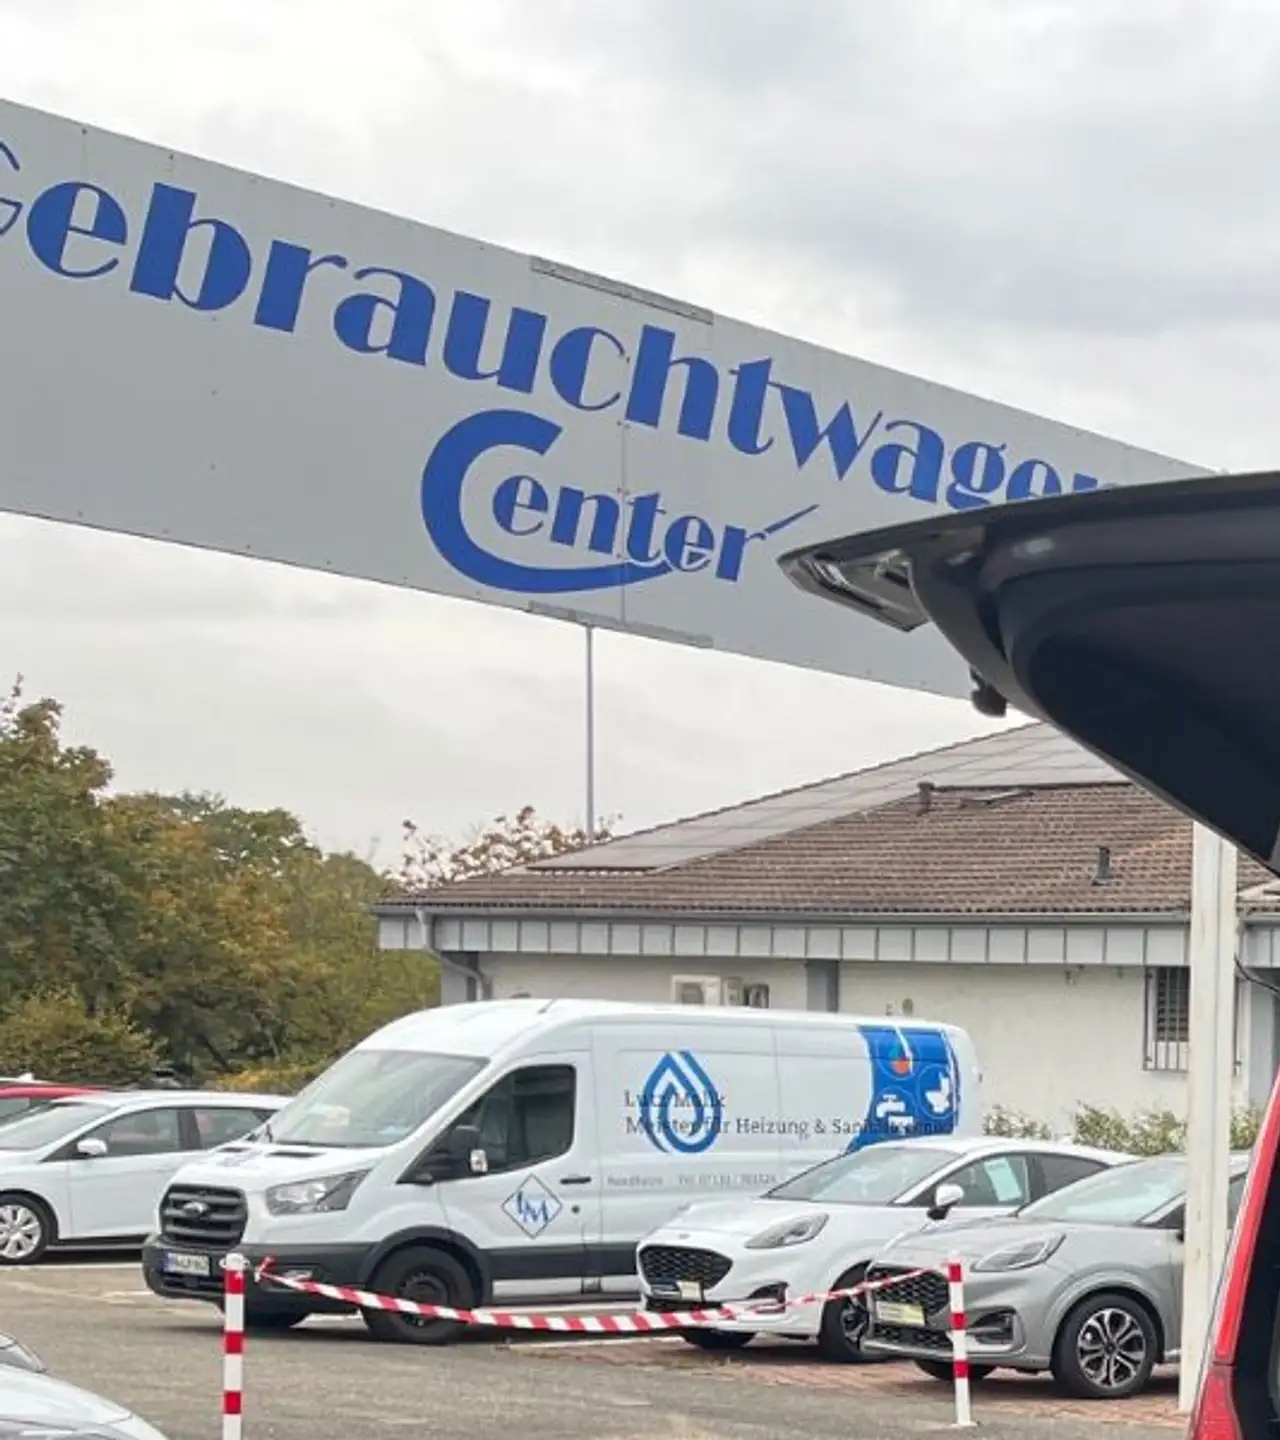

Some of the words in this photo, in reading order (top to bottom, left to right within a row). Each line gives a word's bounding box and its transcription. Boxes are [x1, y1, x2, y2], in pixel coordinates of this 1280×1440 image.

[0, 141, 1099, 511] ebrauchtwage
[420, 408, 819, 594] Center
[736, 1116, 810, 1139] Heizung
[813, 1119, 827, 1135] &
